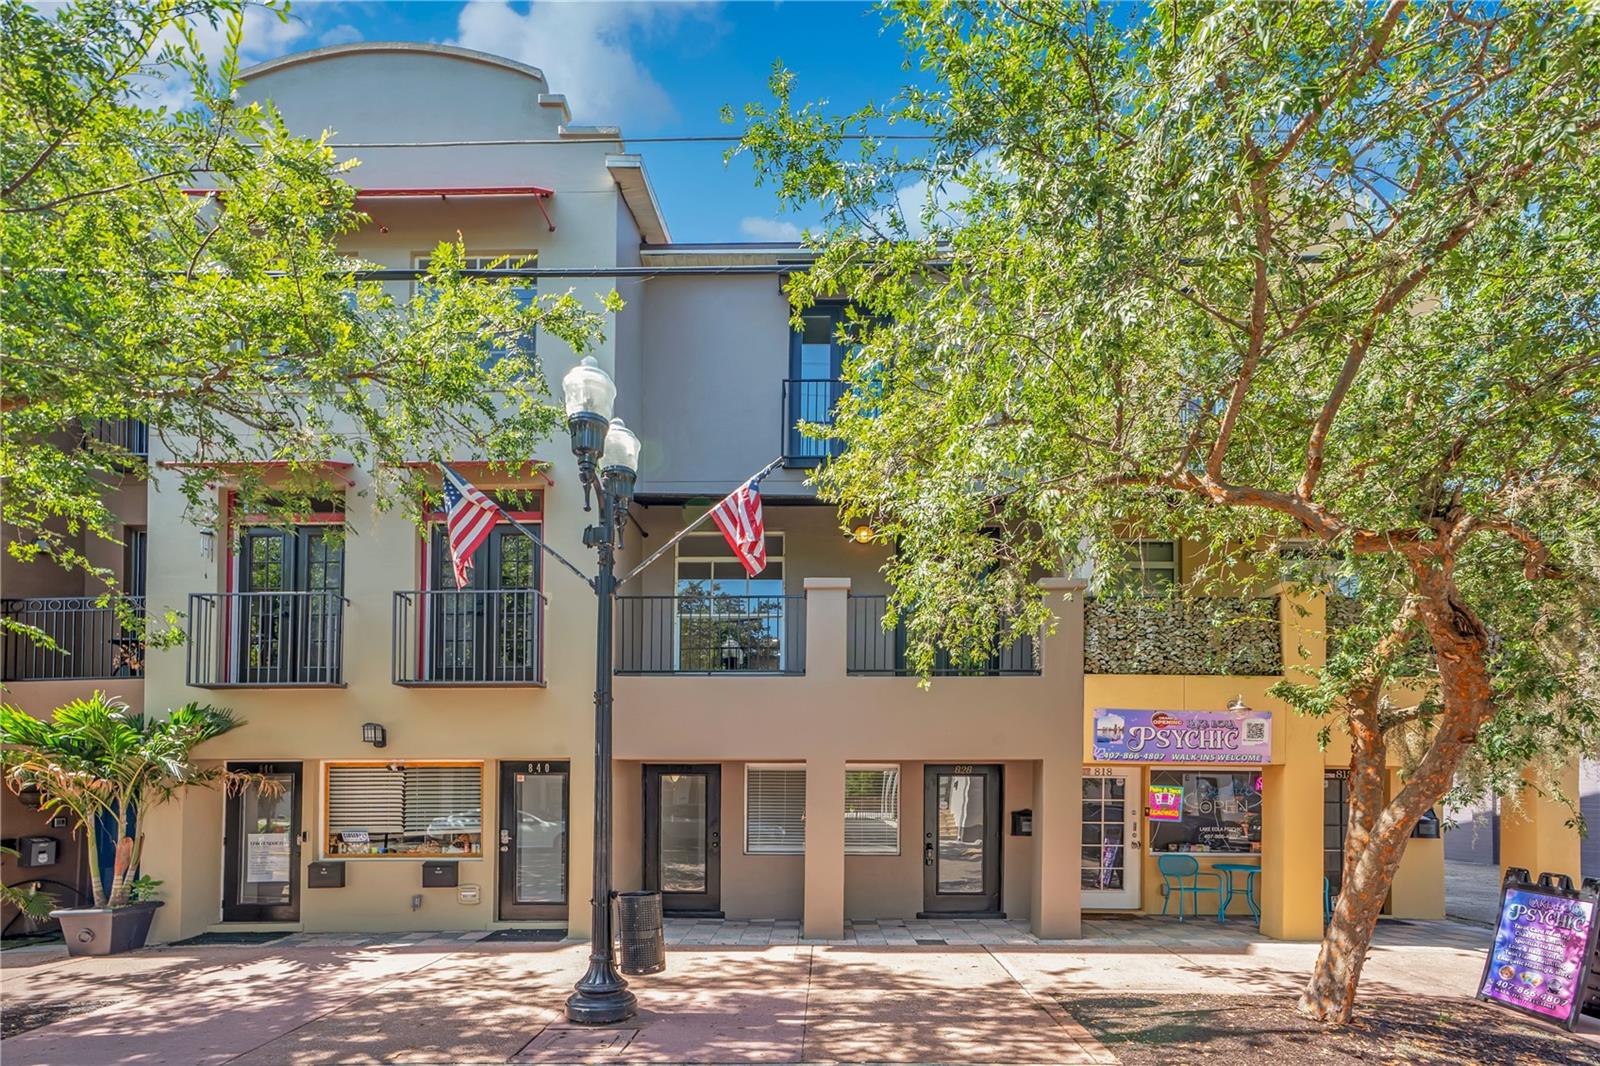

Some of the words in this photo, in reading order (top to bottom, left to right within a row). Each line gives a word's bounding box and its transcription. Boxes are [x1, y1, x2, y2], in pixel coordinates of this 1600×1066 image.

[1126, 726, 1239, 752] PSYCHIC
[1103, 751, 1166, 761] 407-866-4807
[1171, 753, 1216, 762] WALK-INS
[1217, 754, 1263, 762] WELCOME
[527, 763, 550, 773] 840
[954, 765, 973, 774] 828
[1094, 767, 1113, 776] 818
[1199, 799, 1248, 814] OPEN
[1507, 903, 1585, 932] PSYCHIC
[1496, 980, 1568, 1007] 407-866-4807
